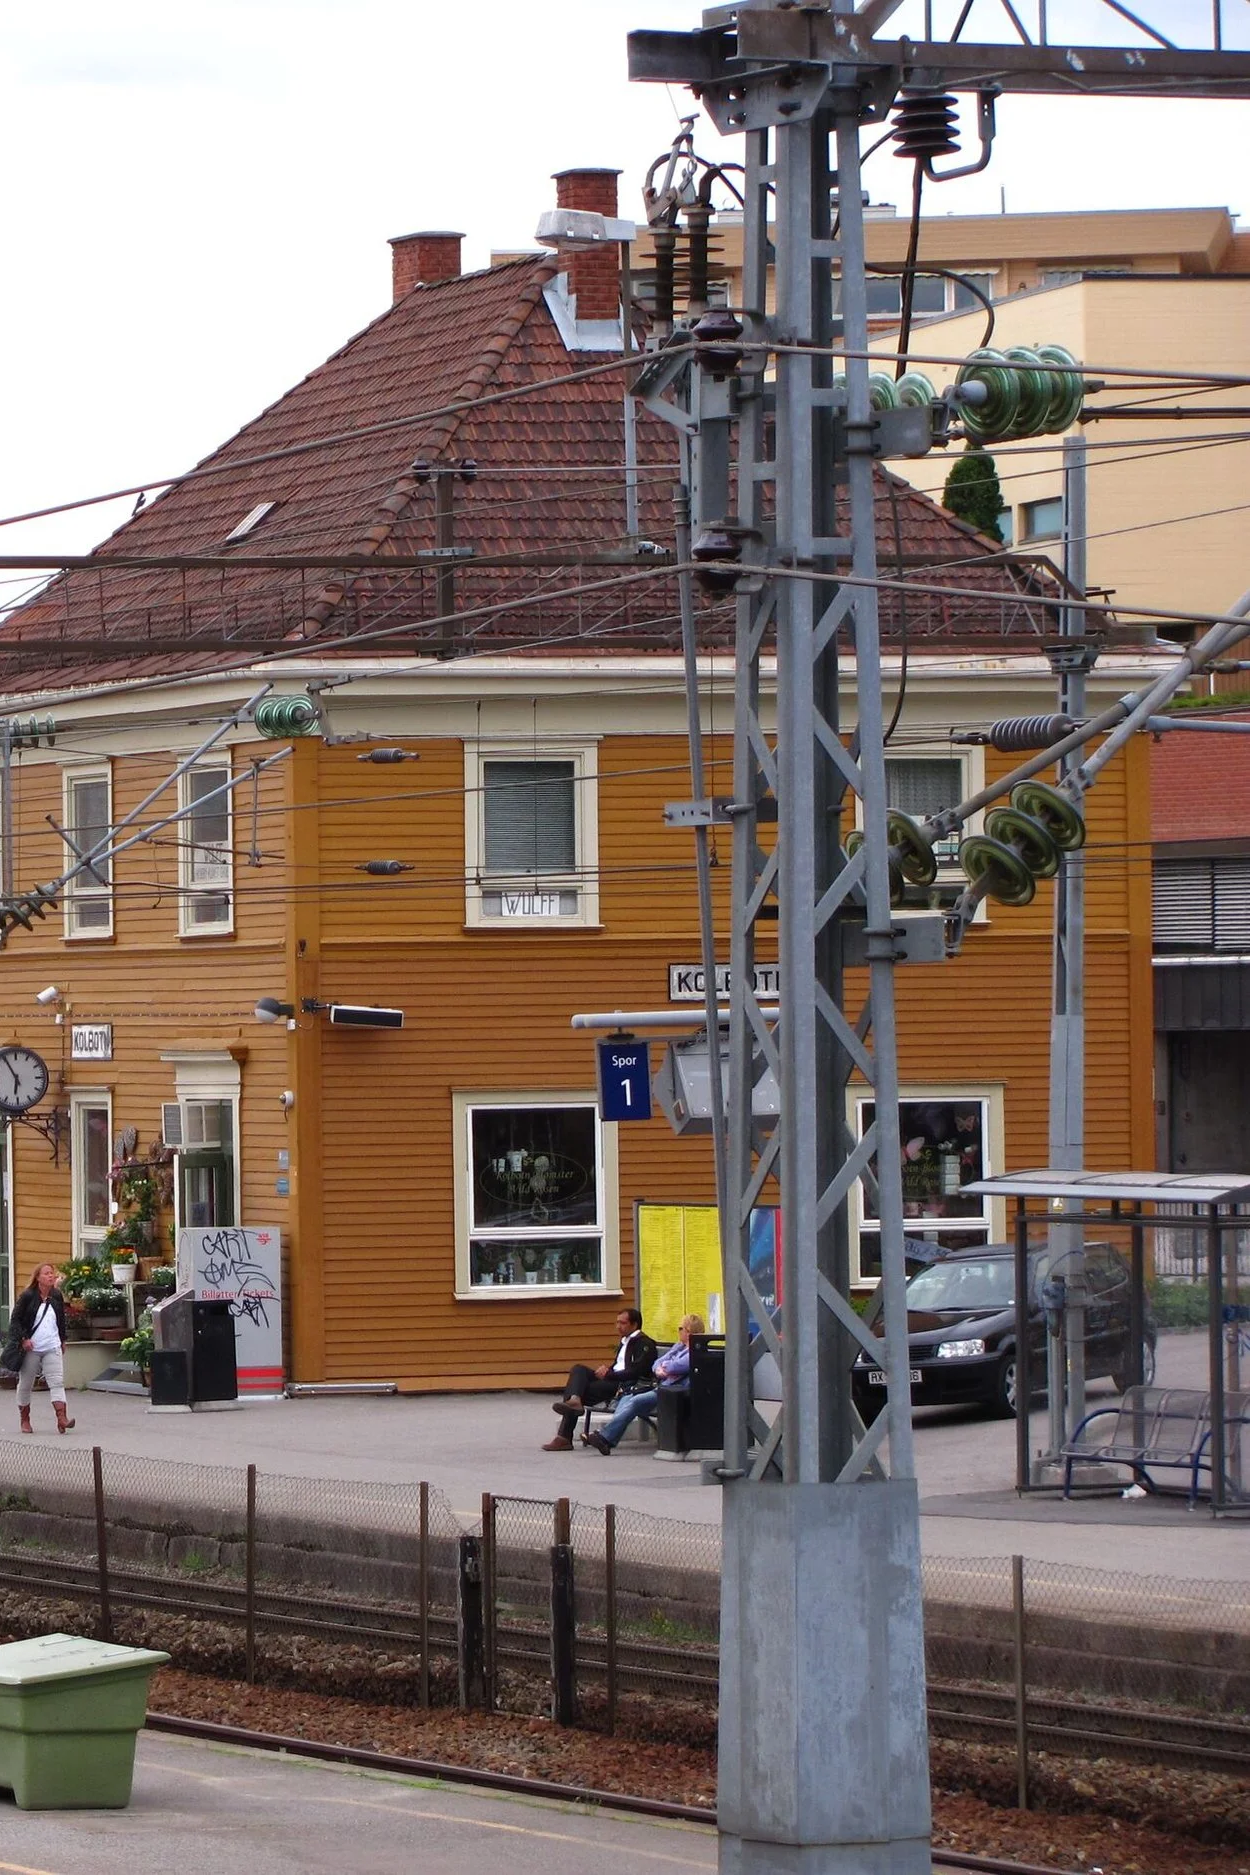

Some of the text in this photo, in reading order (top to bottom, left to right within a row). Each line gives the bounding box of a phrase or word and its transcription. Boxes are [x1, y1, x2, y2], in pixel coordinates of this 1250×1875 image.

[504, 892, 555, 915] WULFF
[611, 1055, 637, 1068] Spor
[620, 1079, 631, 1106] 1
